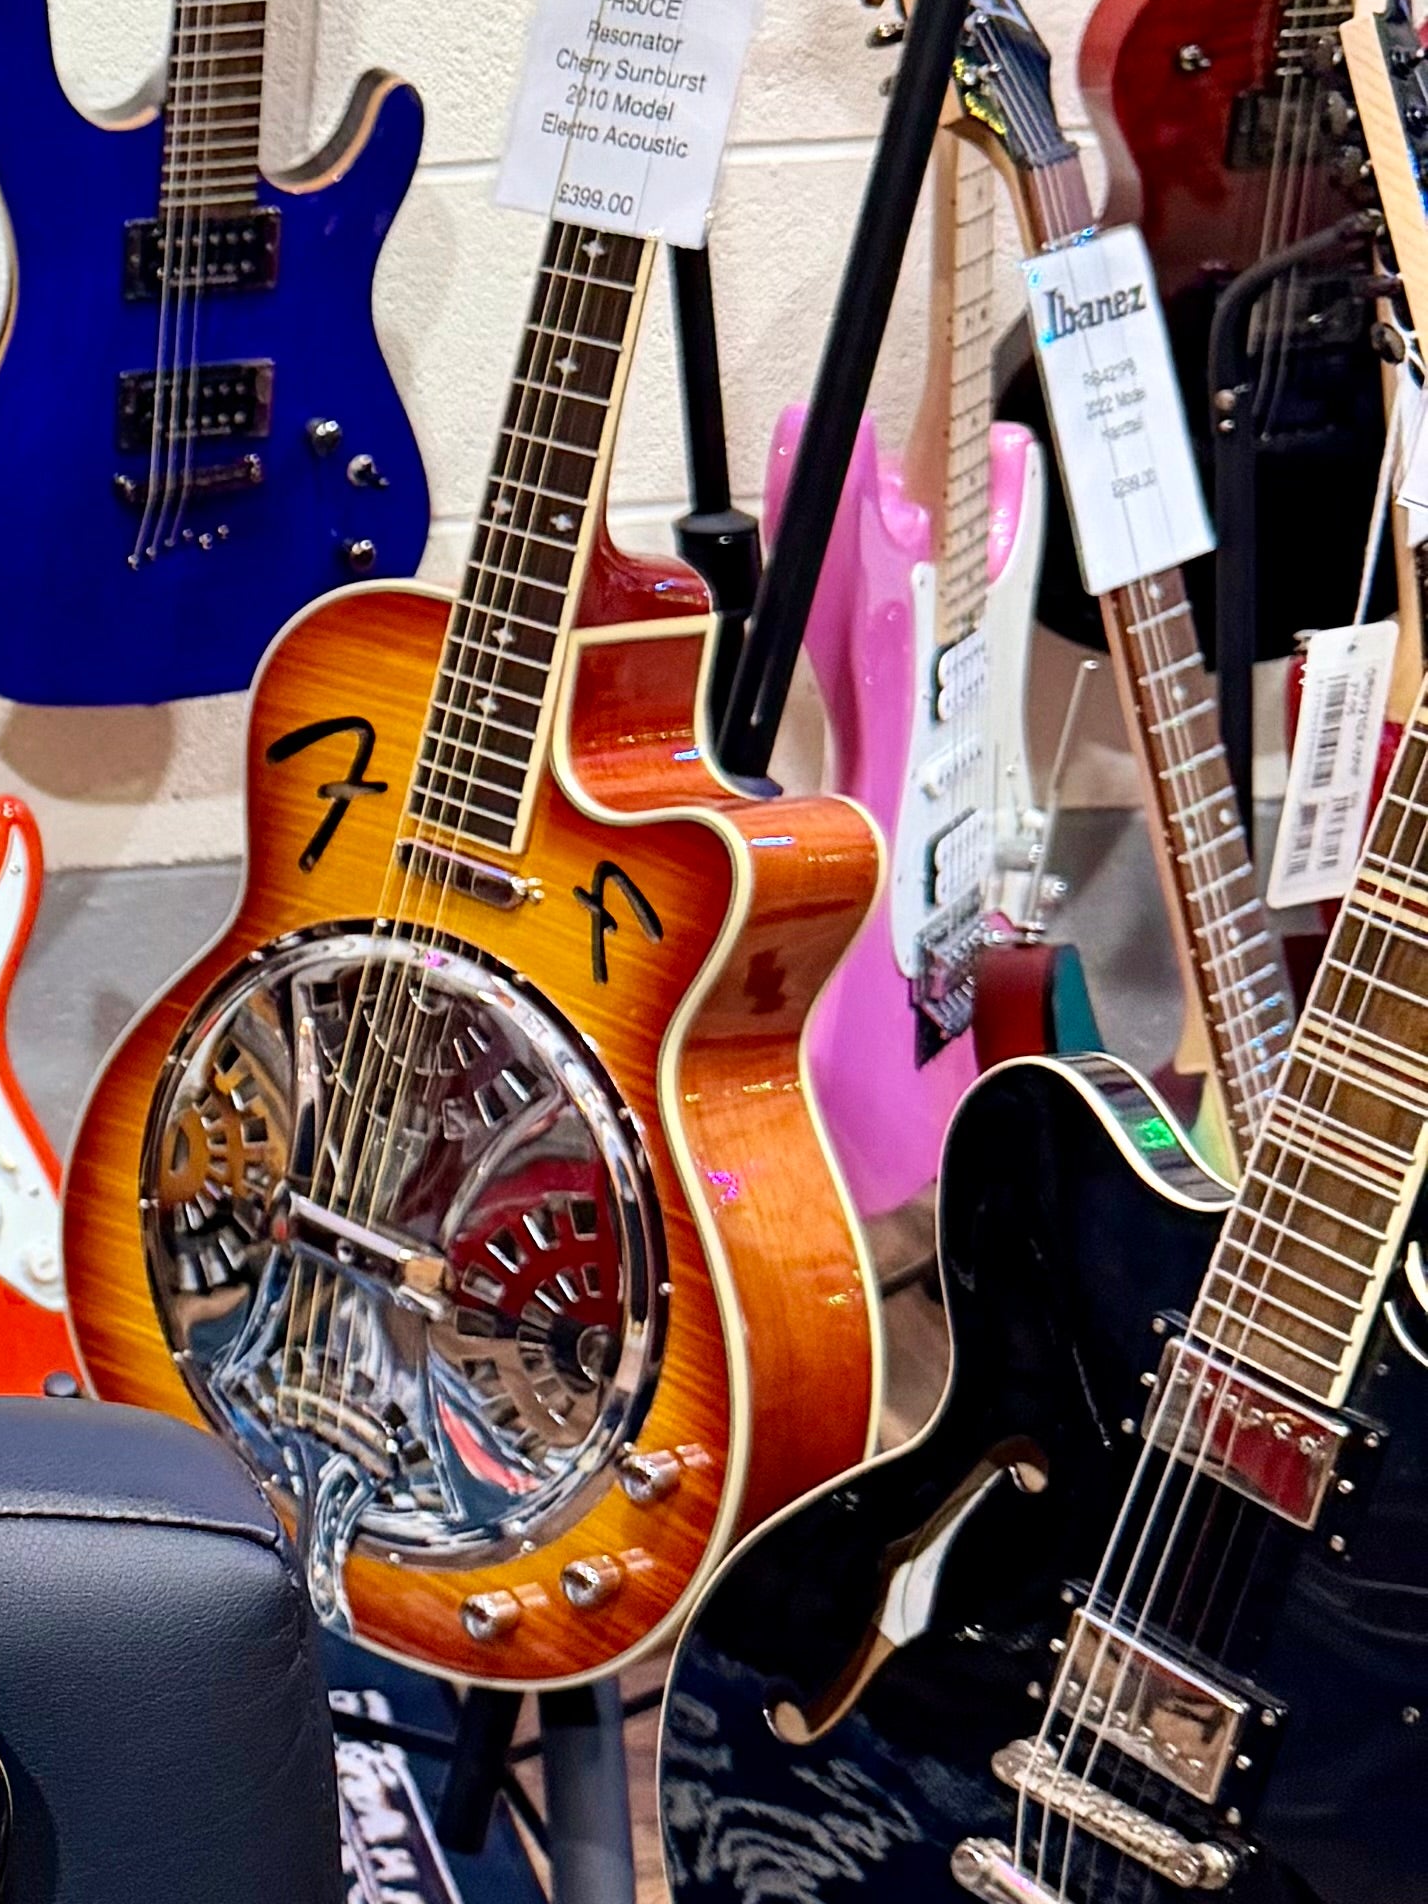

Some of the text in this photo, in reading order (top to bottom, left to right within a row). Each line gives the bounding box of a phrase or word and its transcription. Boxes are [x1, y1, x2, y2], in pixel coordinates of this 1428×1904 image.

[586, 18, 684, 54] Resonator
[556, 47, 709, 94] Cherry Sunburst
[565, 84, 675, 123] 2010 Model
[541, 111, 690, 160] Electro Acoustic
[556, 183, 635, 218] £399.00
[1044, 282, 1147, 340] Ibanez
